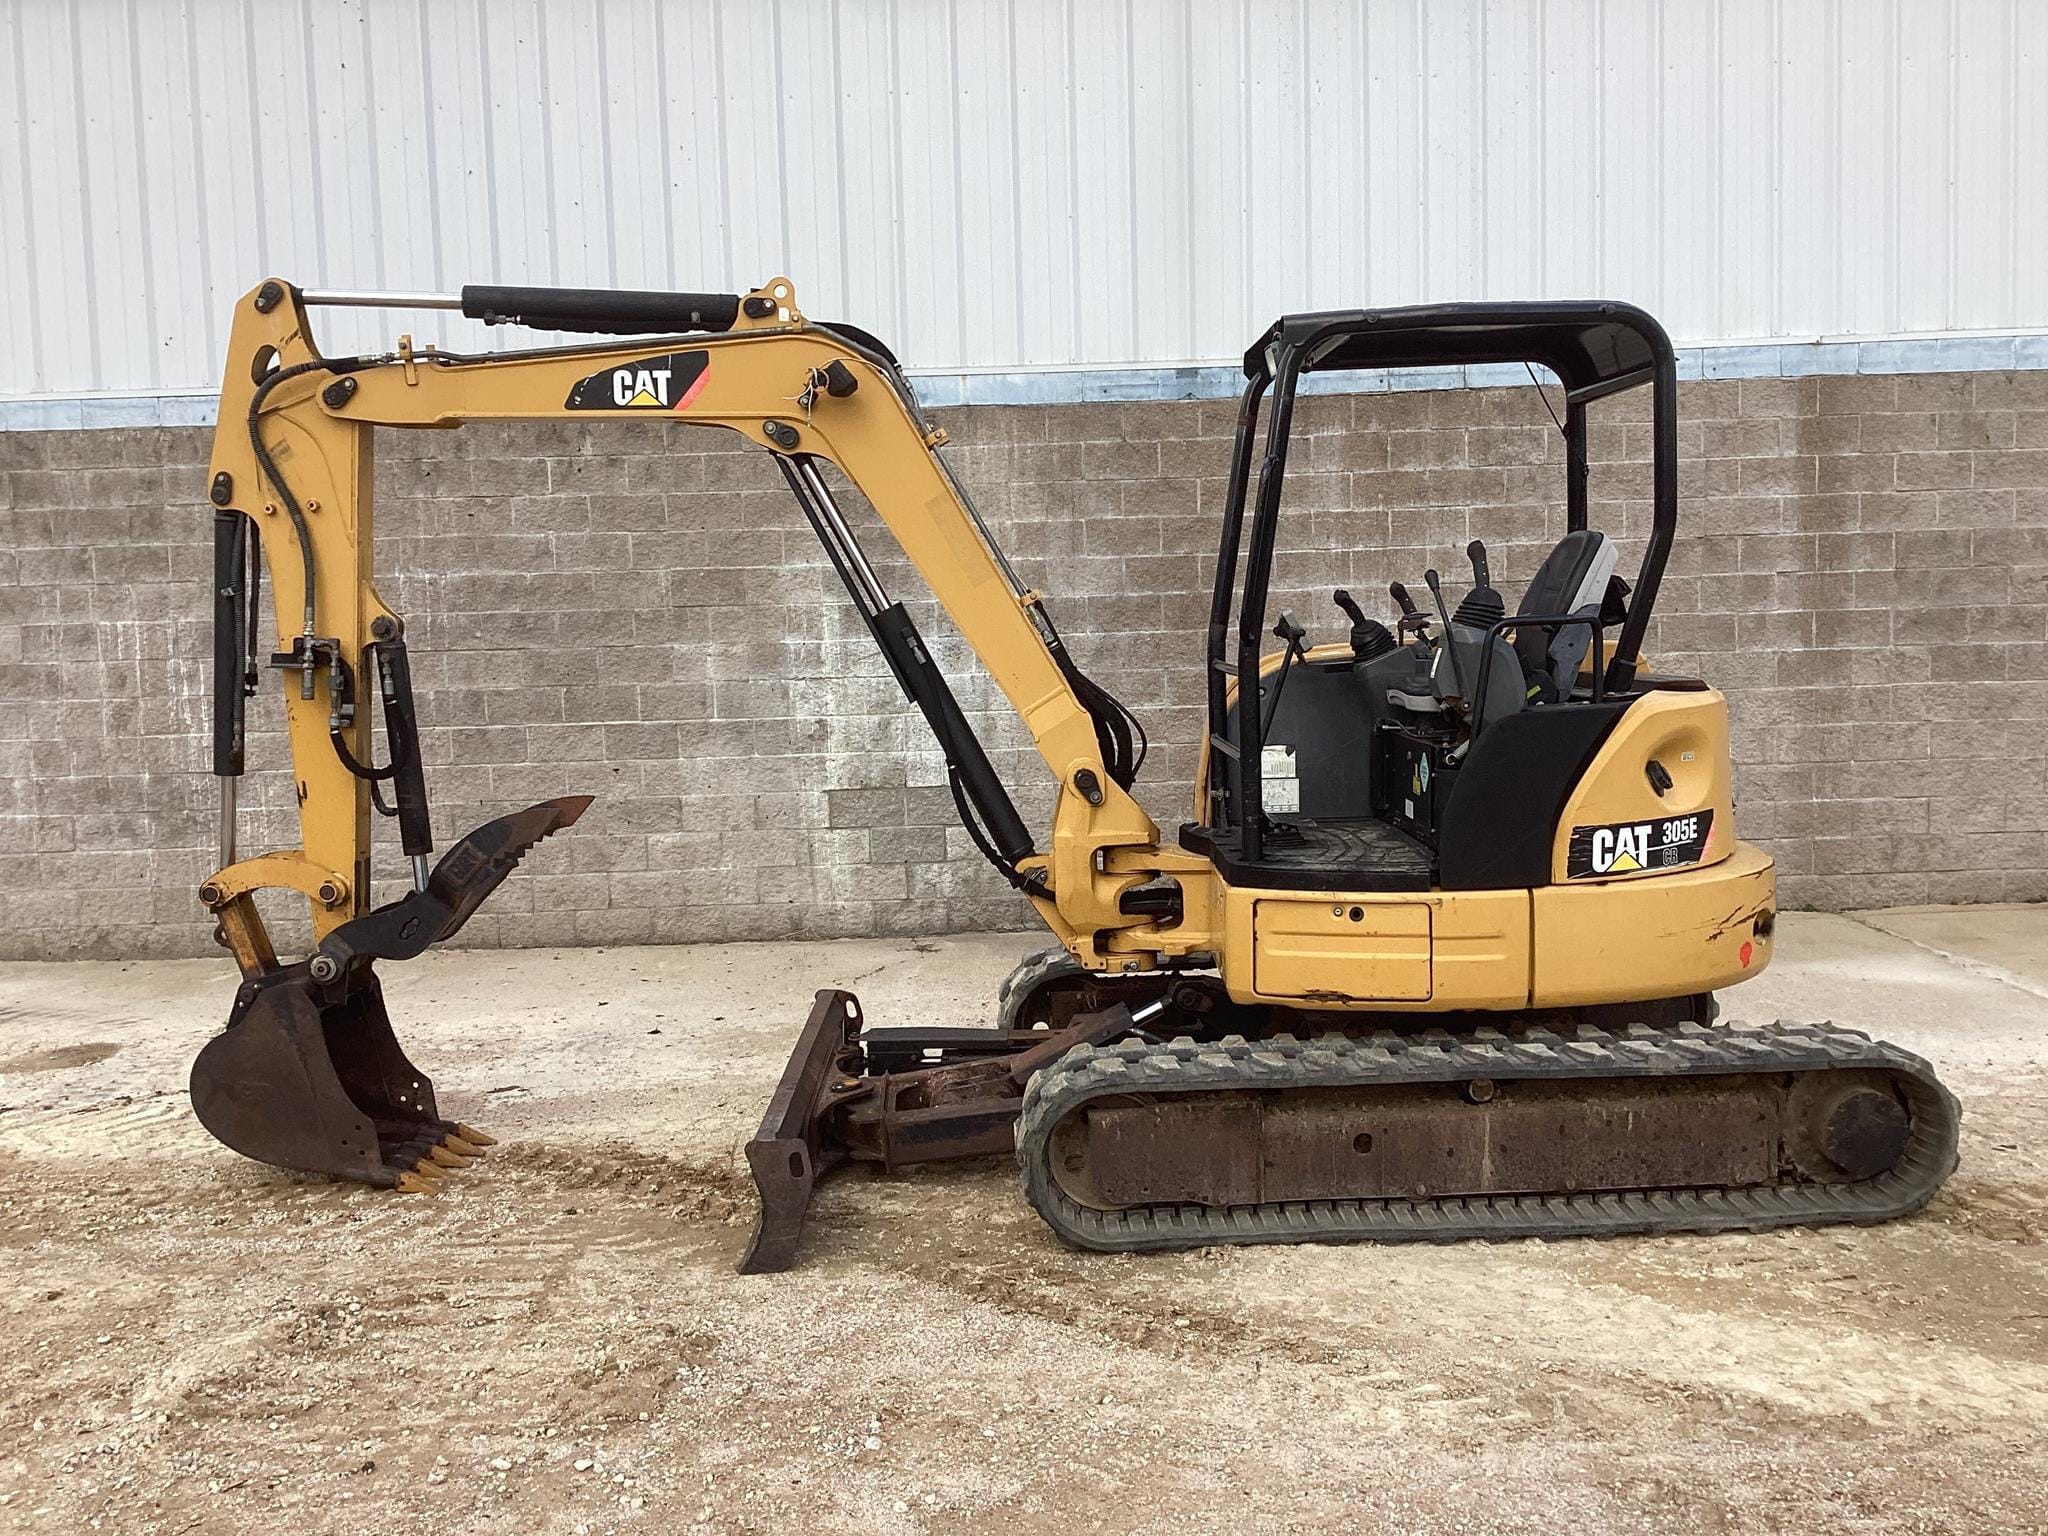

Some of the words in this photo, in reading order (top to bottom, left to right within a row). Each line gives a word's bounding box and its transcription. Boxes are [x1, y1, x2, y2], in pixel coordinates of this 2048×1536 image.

[613, 370, 671, 406] CAT
[1592, 825, 1652, 872] CAT
[1662, 817, 1698, 843] 305E
[1662, 848, 1679, 865] CR
